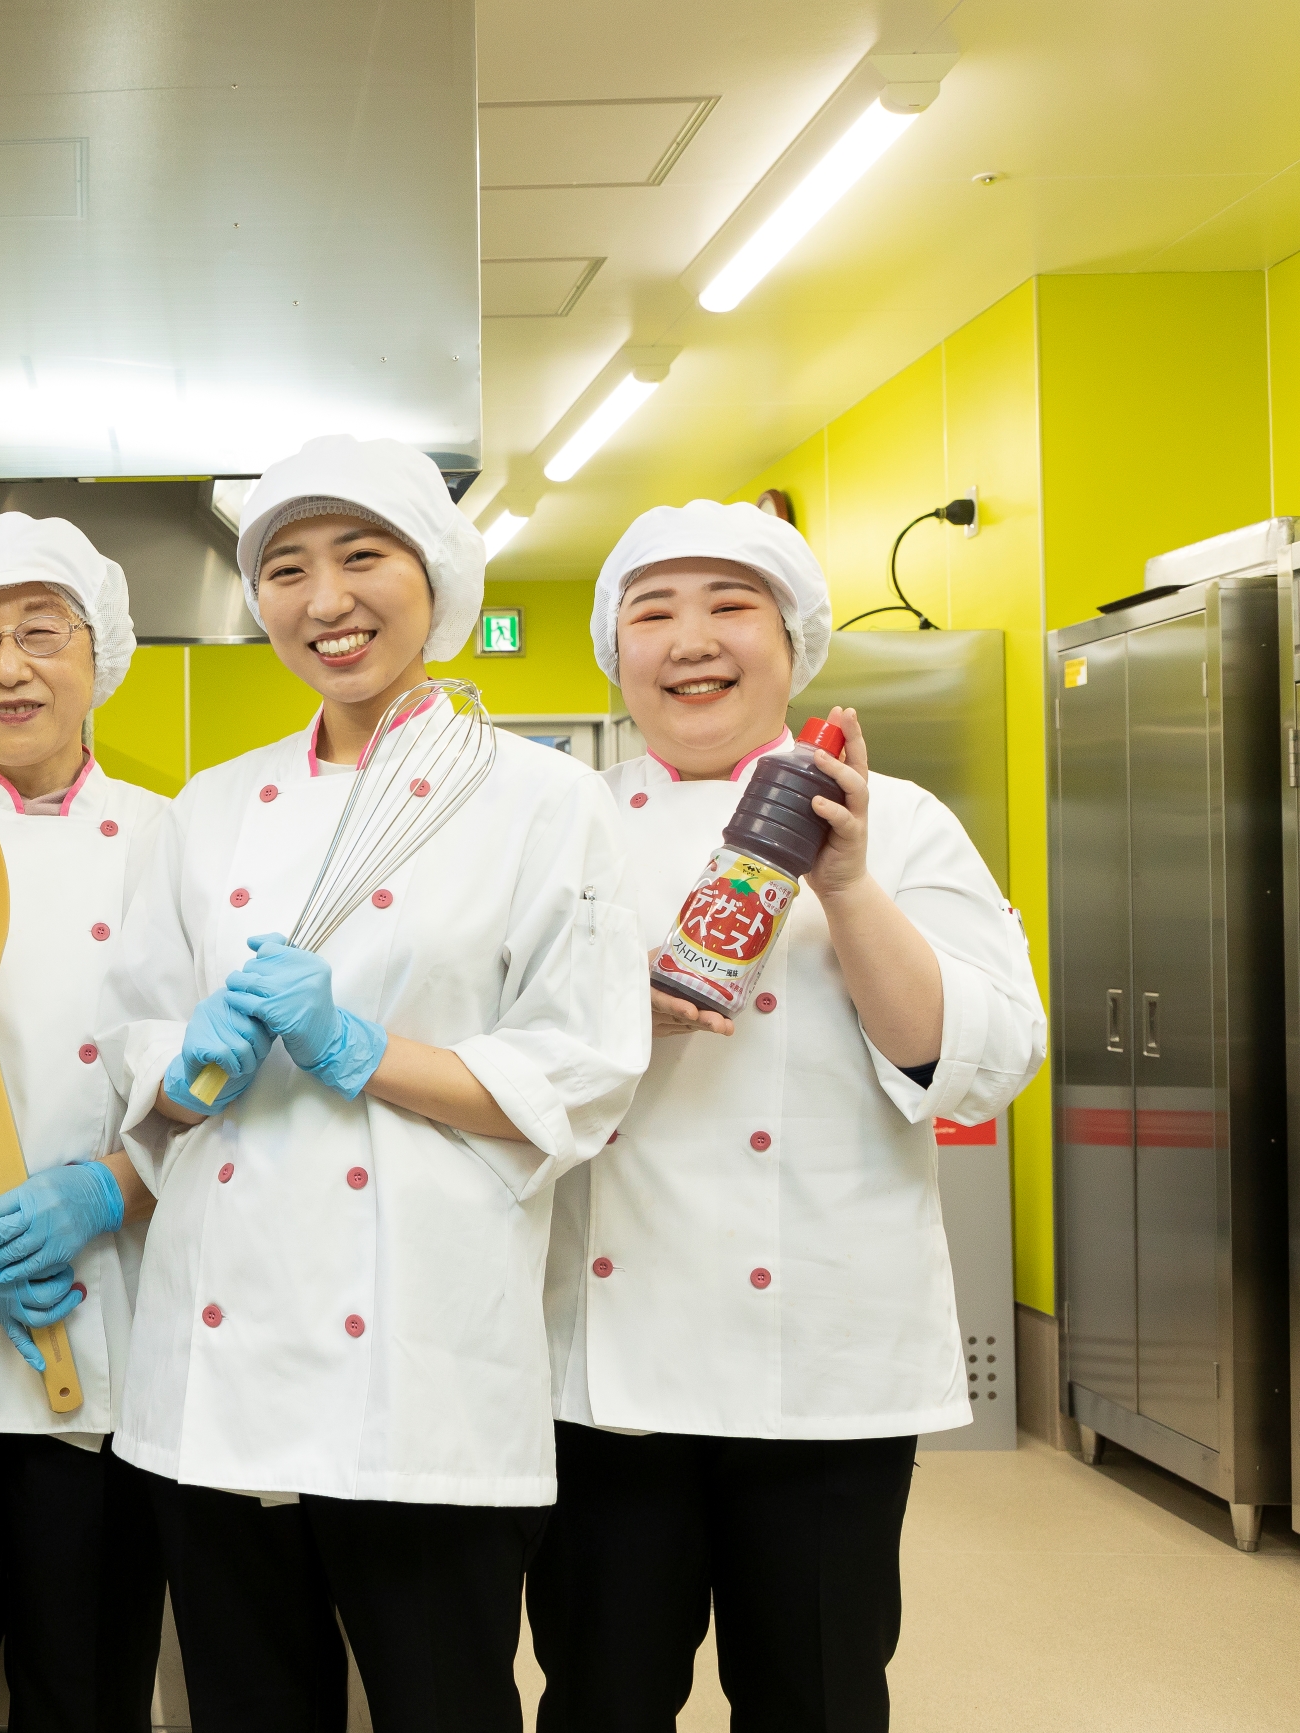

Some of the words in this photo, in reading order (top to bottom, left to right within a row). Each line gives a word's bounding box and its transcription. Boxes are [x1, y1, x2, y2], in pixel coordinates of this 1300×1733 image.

[693, 888, 765, 935] デザート
[687, 914, 752, 958] ベース
